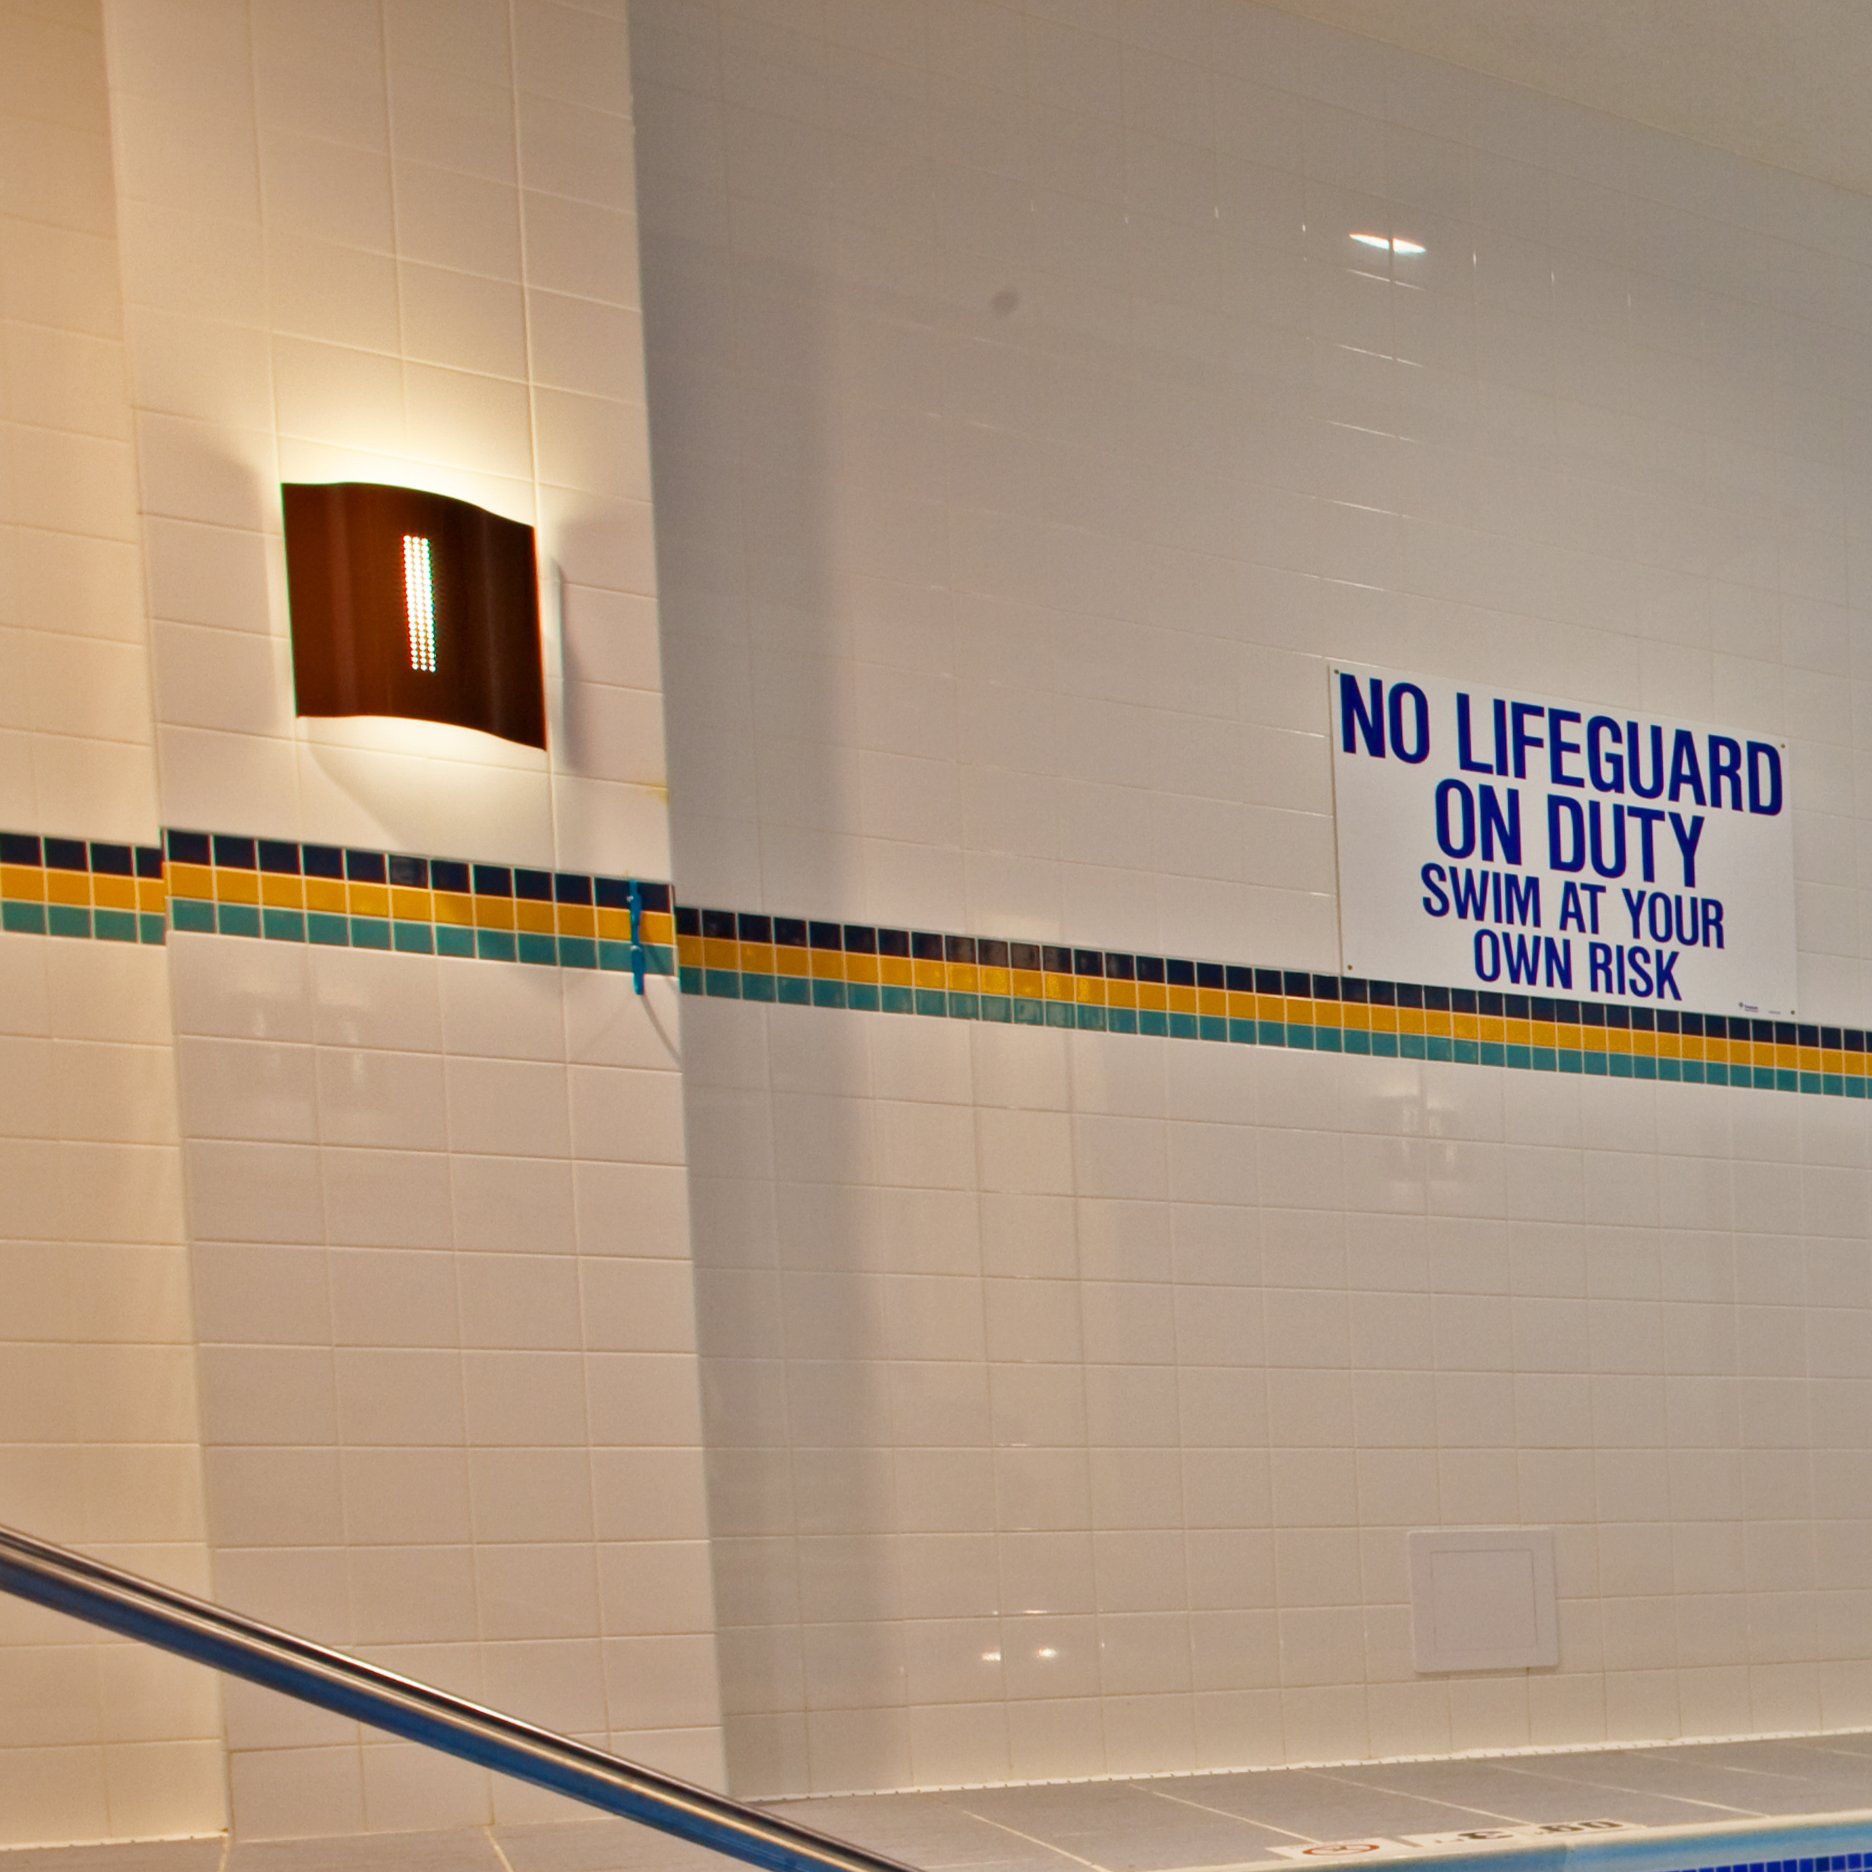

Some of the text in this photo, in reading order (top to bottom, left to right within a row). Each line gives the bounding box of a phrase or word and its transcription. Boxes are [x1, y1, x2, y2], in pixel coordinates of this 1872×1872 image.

[1338, 672, 1784, 817] NO LIFEGUARD
[1434, 778, 1706, 888] ON DUTY
[1420, 862, 1726, 950] SWIM AT YOUR
[1473, 928, 1683, 1001] OWN RISK
